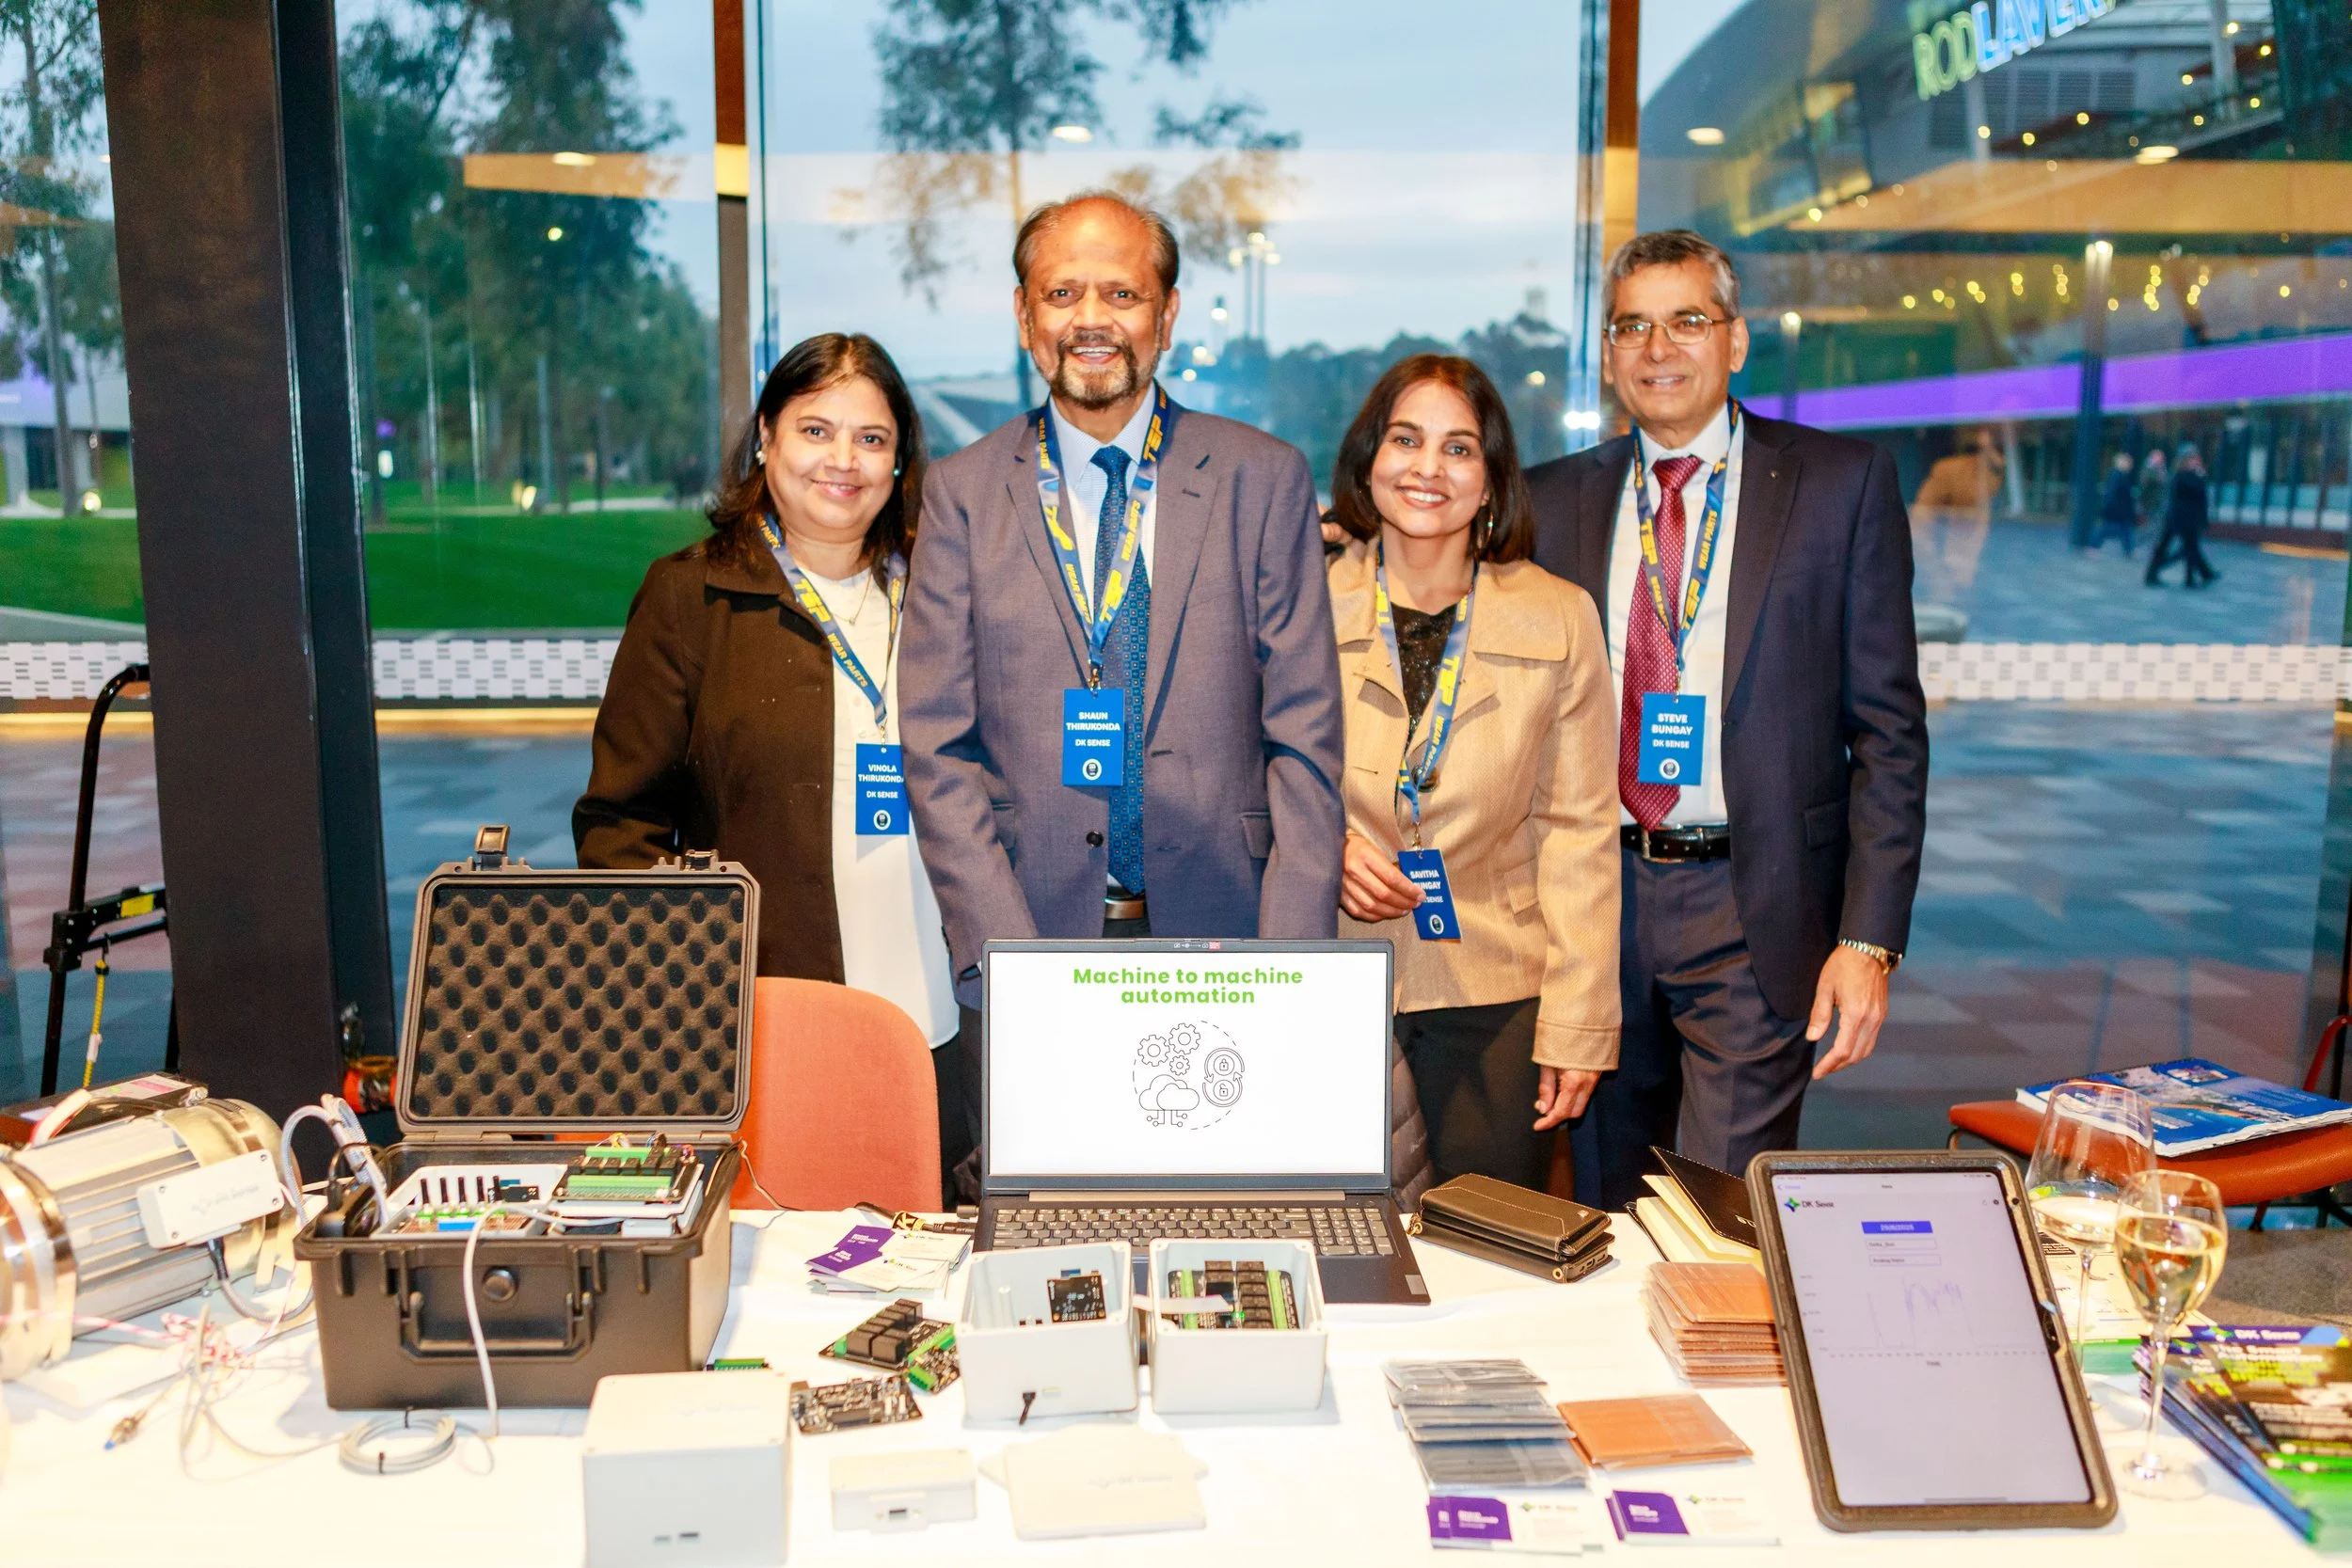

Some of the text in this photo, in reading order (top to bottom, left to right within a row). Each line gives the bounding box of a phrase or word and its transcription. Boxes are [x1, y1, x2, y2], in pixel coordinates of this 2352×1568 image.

[1913, 10, 1978, 101] ROD
[1698, 509, 1718, 571] WEAR PARTS
[827, 632, 868, 689] WEAR PARTS
[1078, 711, 1108, 721] SHAUN
[1658, 713, 1689, 723] STEVE
[1065, 721, 1121, 731] THIRUKONDA
[1651, 723, 1693, 736] BUNGAY
[1075, 738, 1111, 747] DK SENSE
[1652, 738, 1690, 750] DK SENSE
[867, 764, 898, 773] VINOLA
[866, 790, 898, 800] DK SENSE
[1409, 869, 1440, 879] SAVITHA
[1073, 967, 1304, 984] Machine to machine
[1120, 986, 1255, 1004] automation
